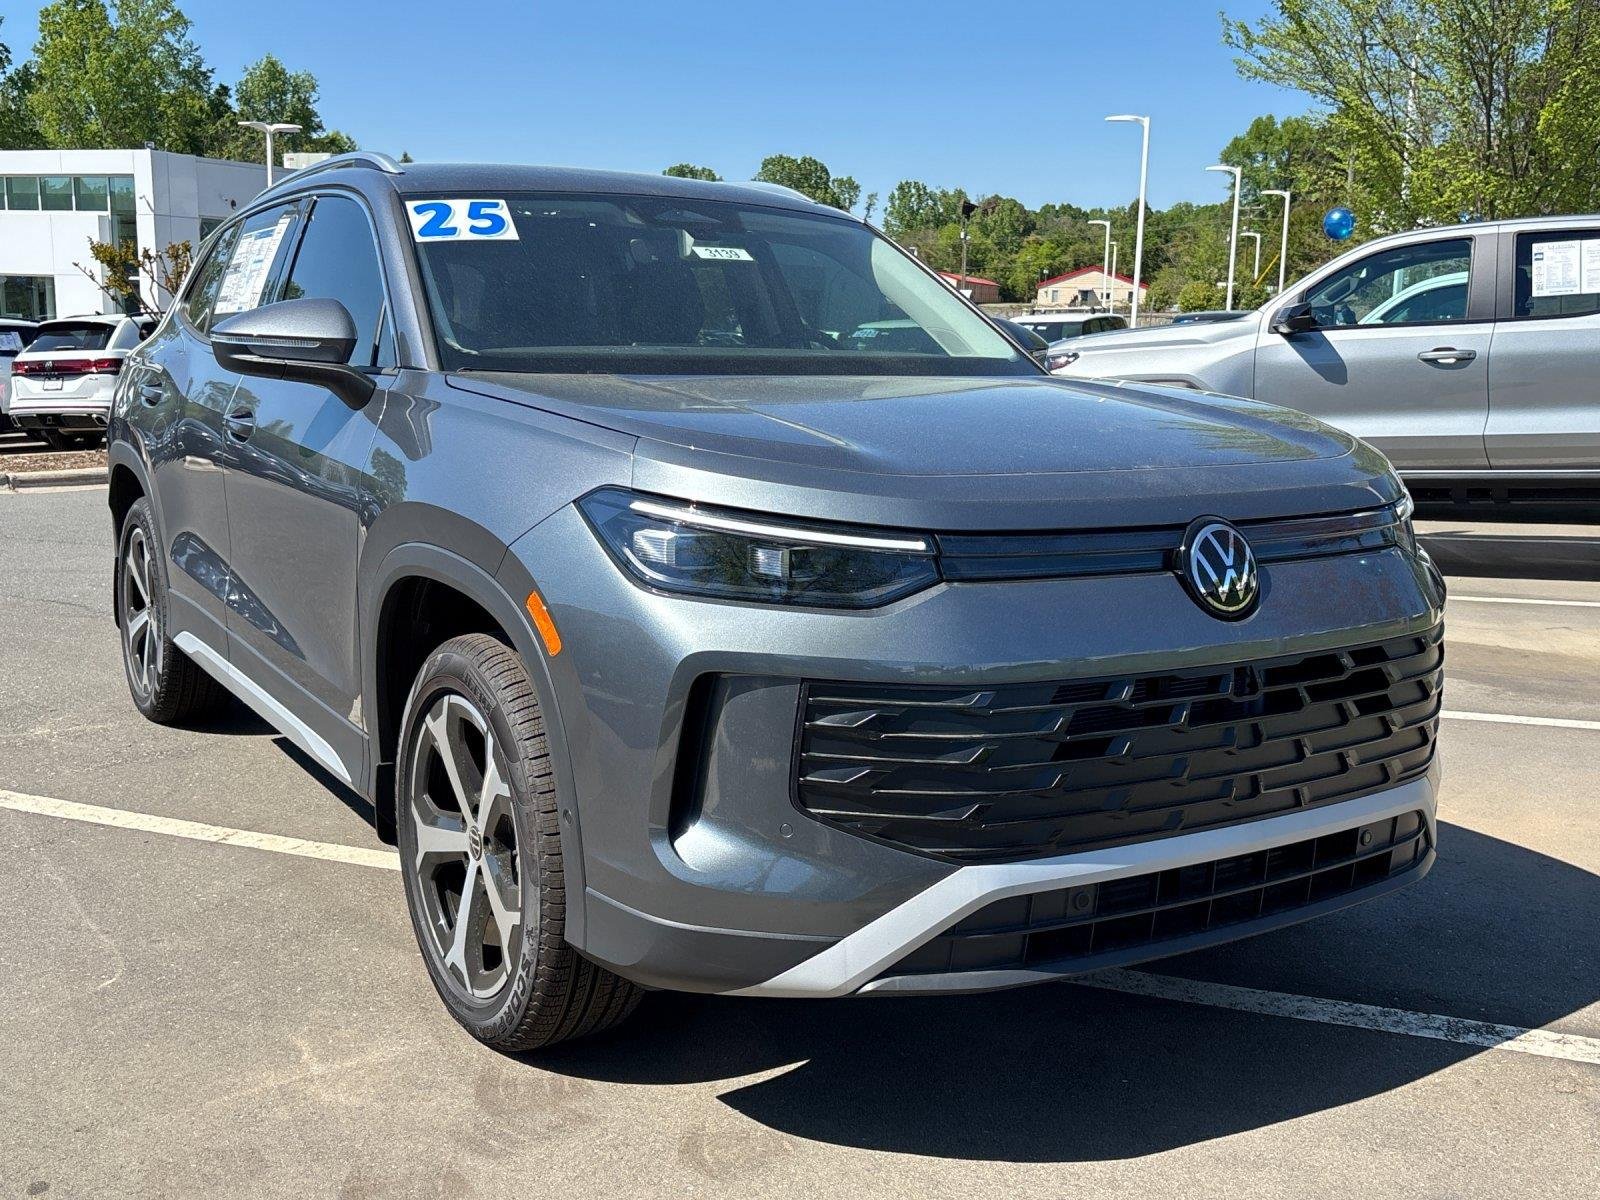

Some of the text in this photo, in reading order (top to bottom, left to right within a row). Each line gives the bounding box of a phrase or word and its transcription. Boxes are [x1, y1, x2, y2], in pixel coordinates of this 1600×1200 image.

[413, 202, 509, 238] 25
[705, 248, 741, 259] 3139
[1192, 525, 1250, 608] VW
